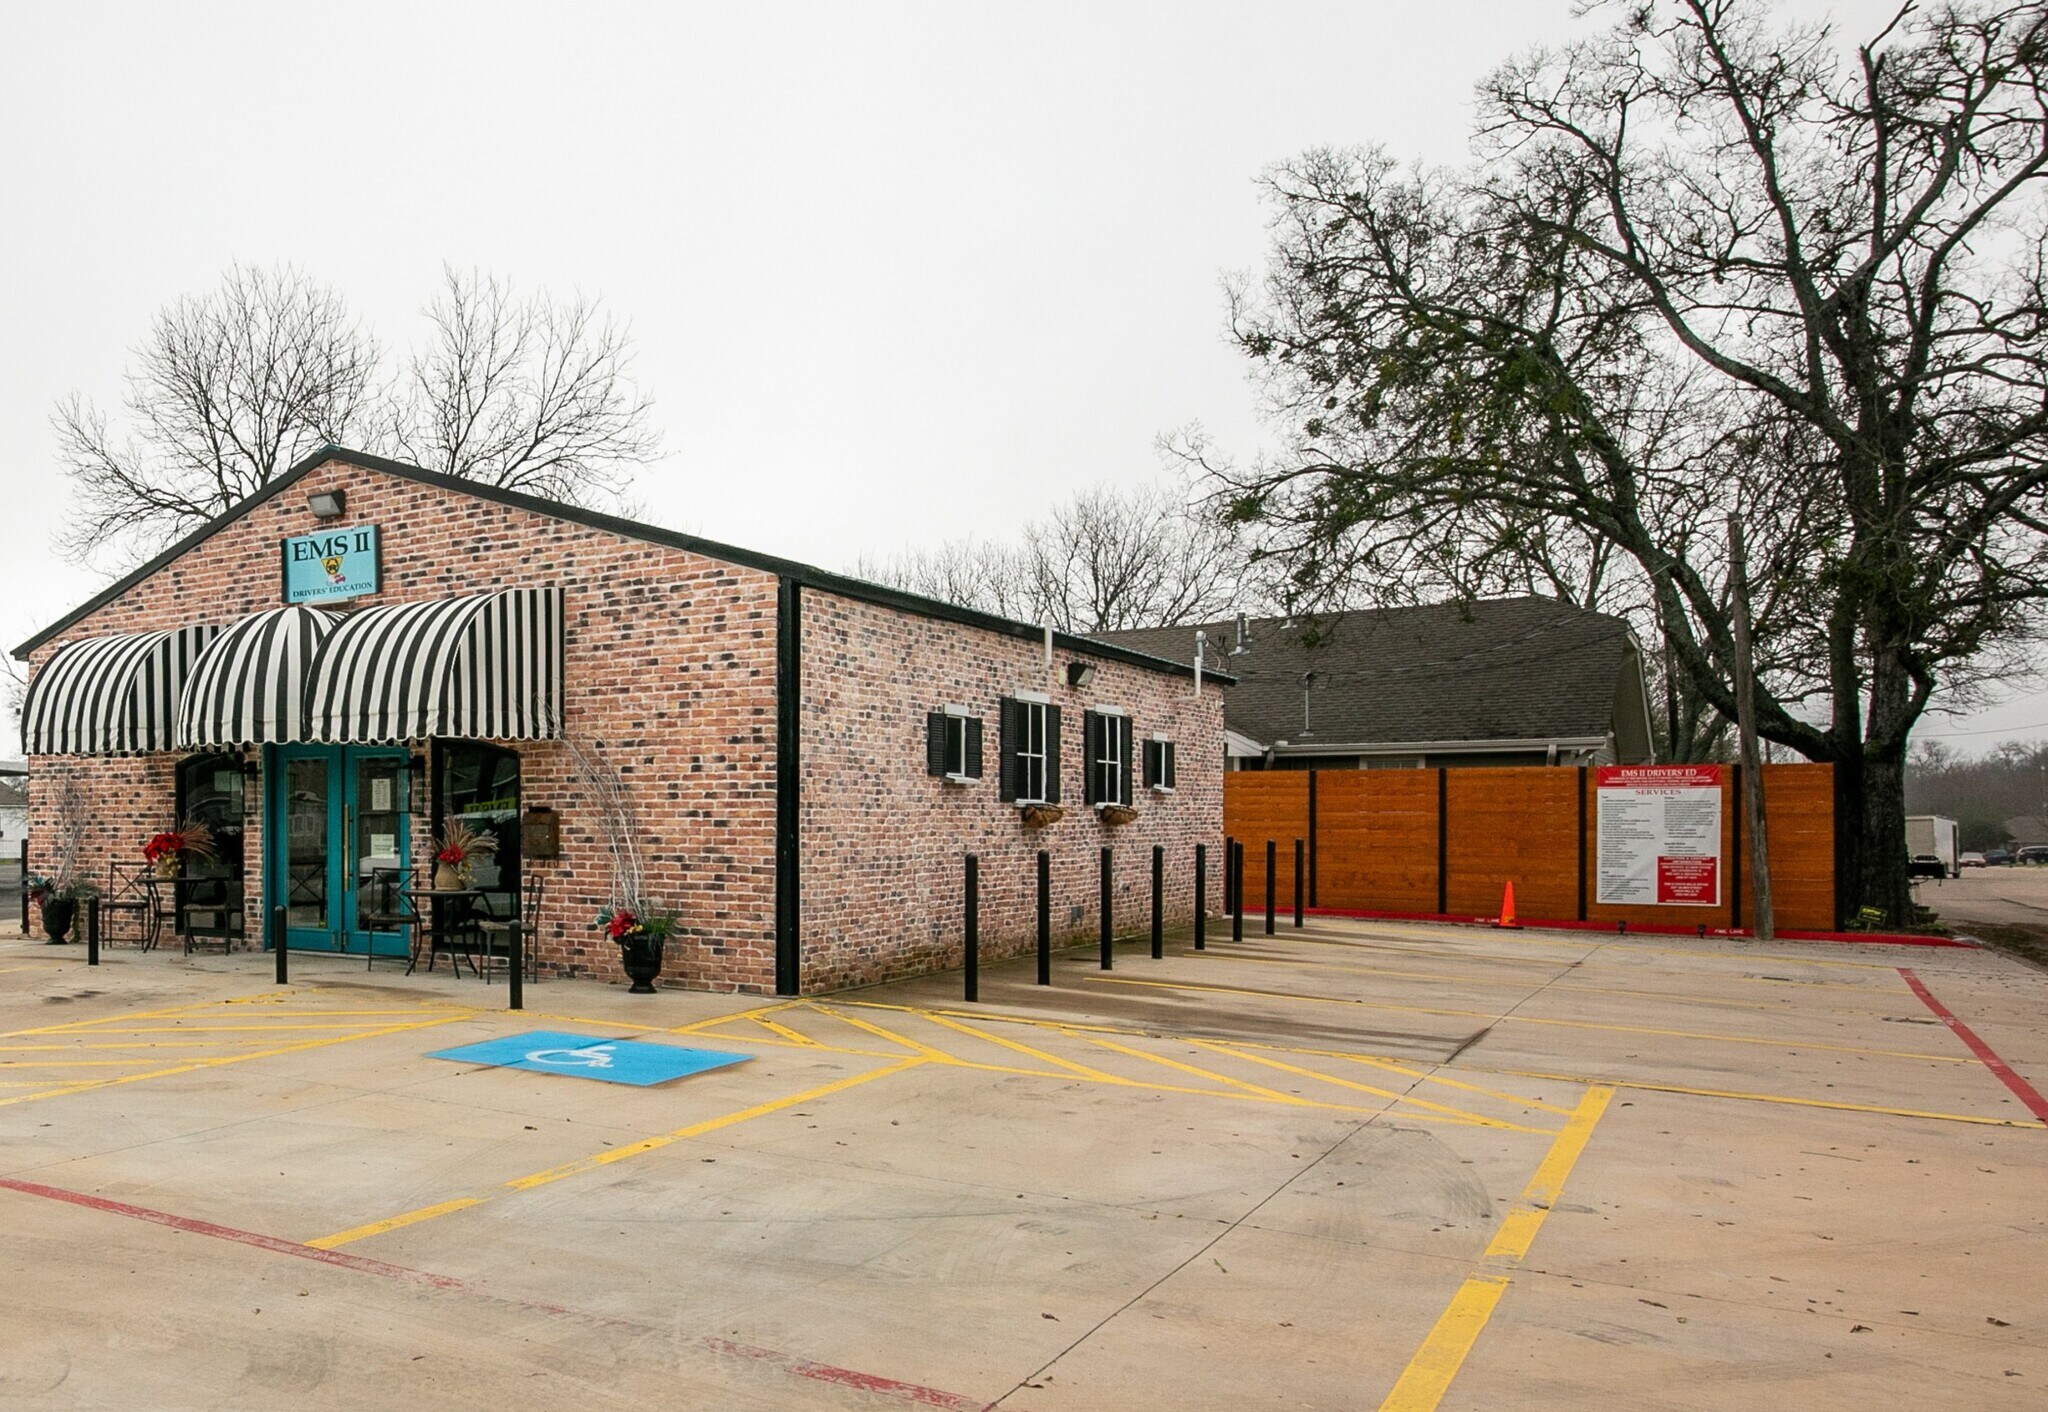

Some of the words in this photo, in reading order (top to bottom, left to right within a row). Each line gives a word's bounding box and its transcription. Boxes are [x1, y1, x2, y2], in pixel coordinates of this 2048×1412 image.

[292, 535, 349, 562] EMS
[354, 532, 371, 553] II
[293, 587, 328, 597] DRIVERS'
[329, 582, 373, 593] EDUCATION
